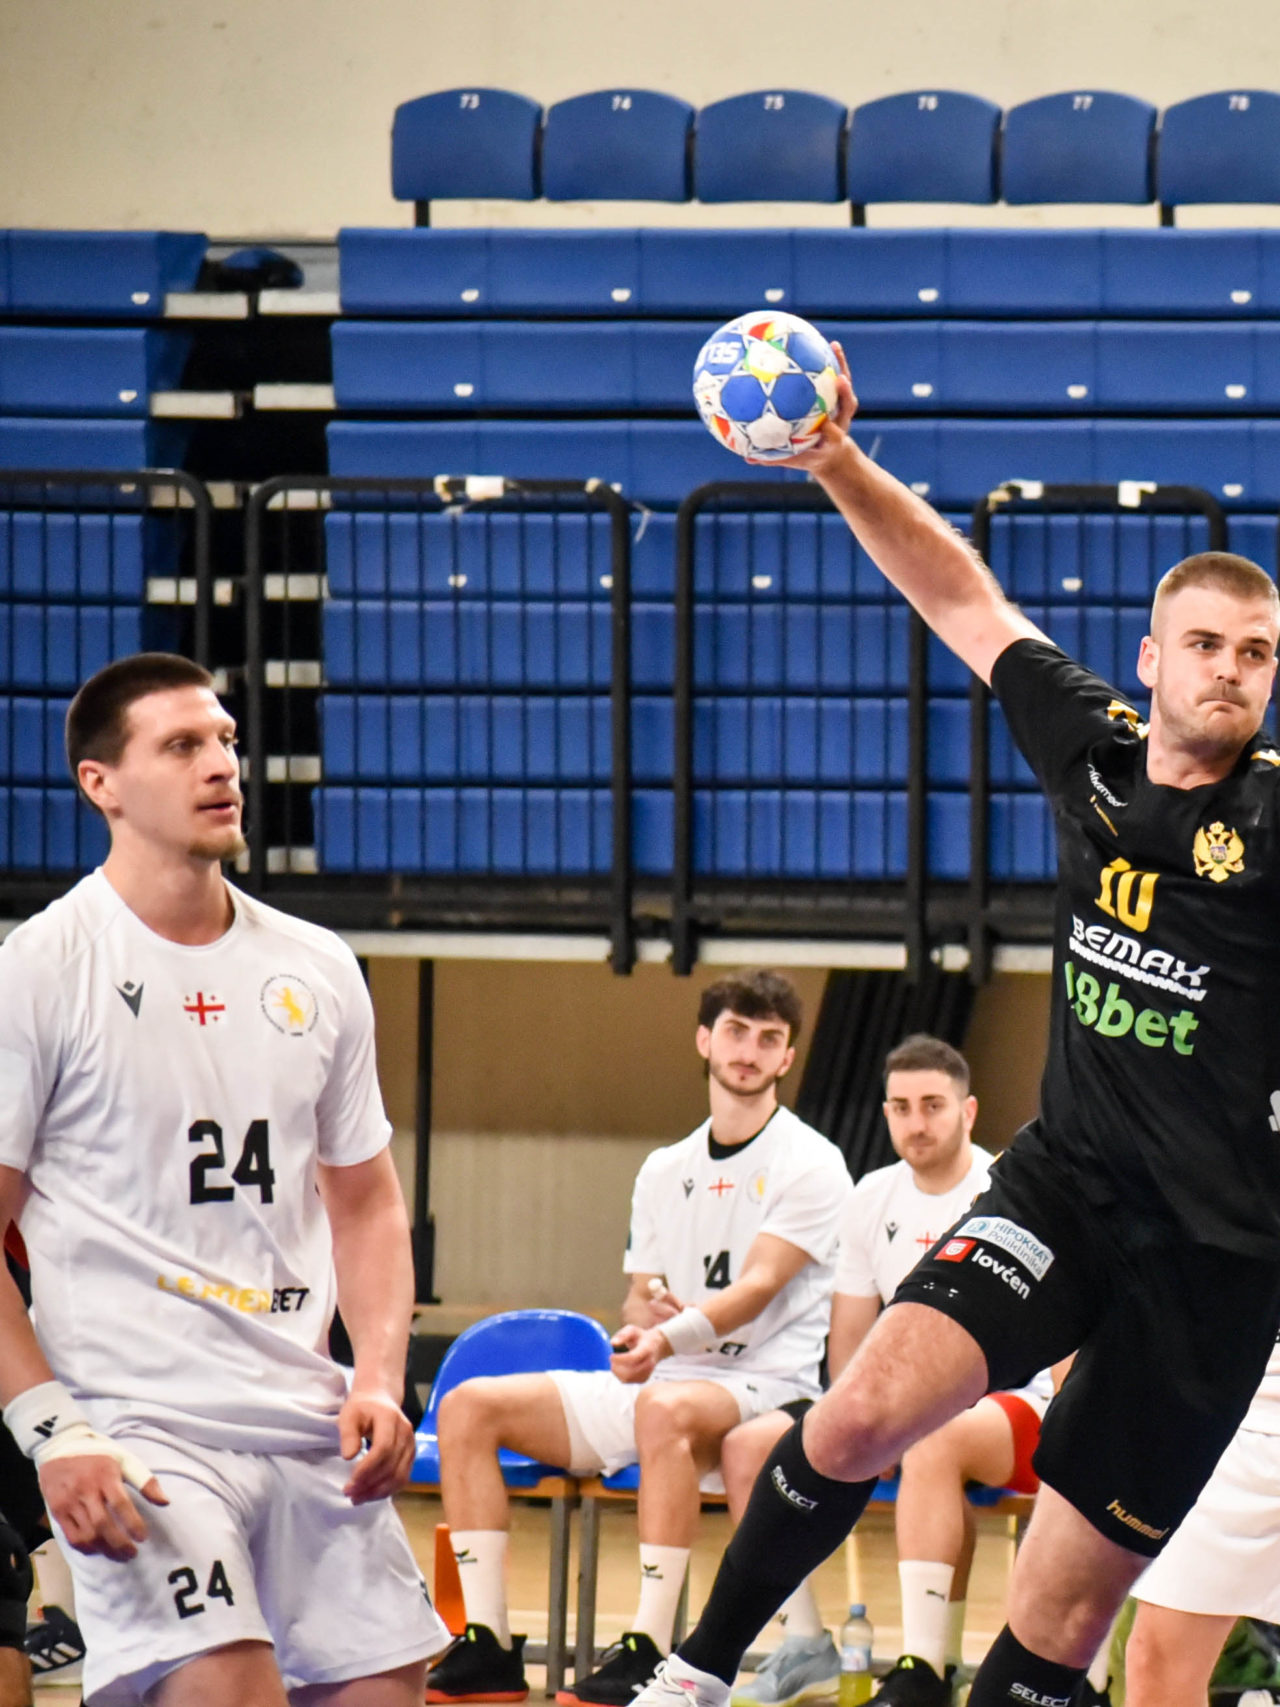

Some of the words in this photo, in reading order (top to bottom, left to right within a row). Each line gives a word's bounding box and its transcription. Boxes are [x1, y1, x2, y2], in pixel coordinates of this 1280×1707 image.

[459, 93, 480, 109] 73
[611, 94, 633, 111] 74
[1072, 95, 1094, 111] 77
[1094, 857, 1160, 933] 10
[1071, 914, 1210, 986] BEMAX
[188, 1119, 275, 1205] 24
[993, 1222, 1049, 1265] HIPOKRAT
[971, 1247, 1031, 1301] lovćen
[772, 1465, 819, 1510] SELECT
[1106, 1499, 1170, 1540] hummel
[167, 1560, 235, 1619] 24
[1010, 1681, 1071, 1707] SELECT
